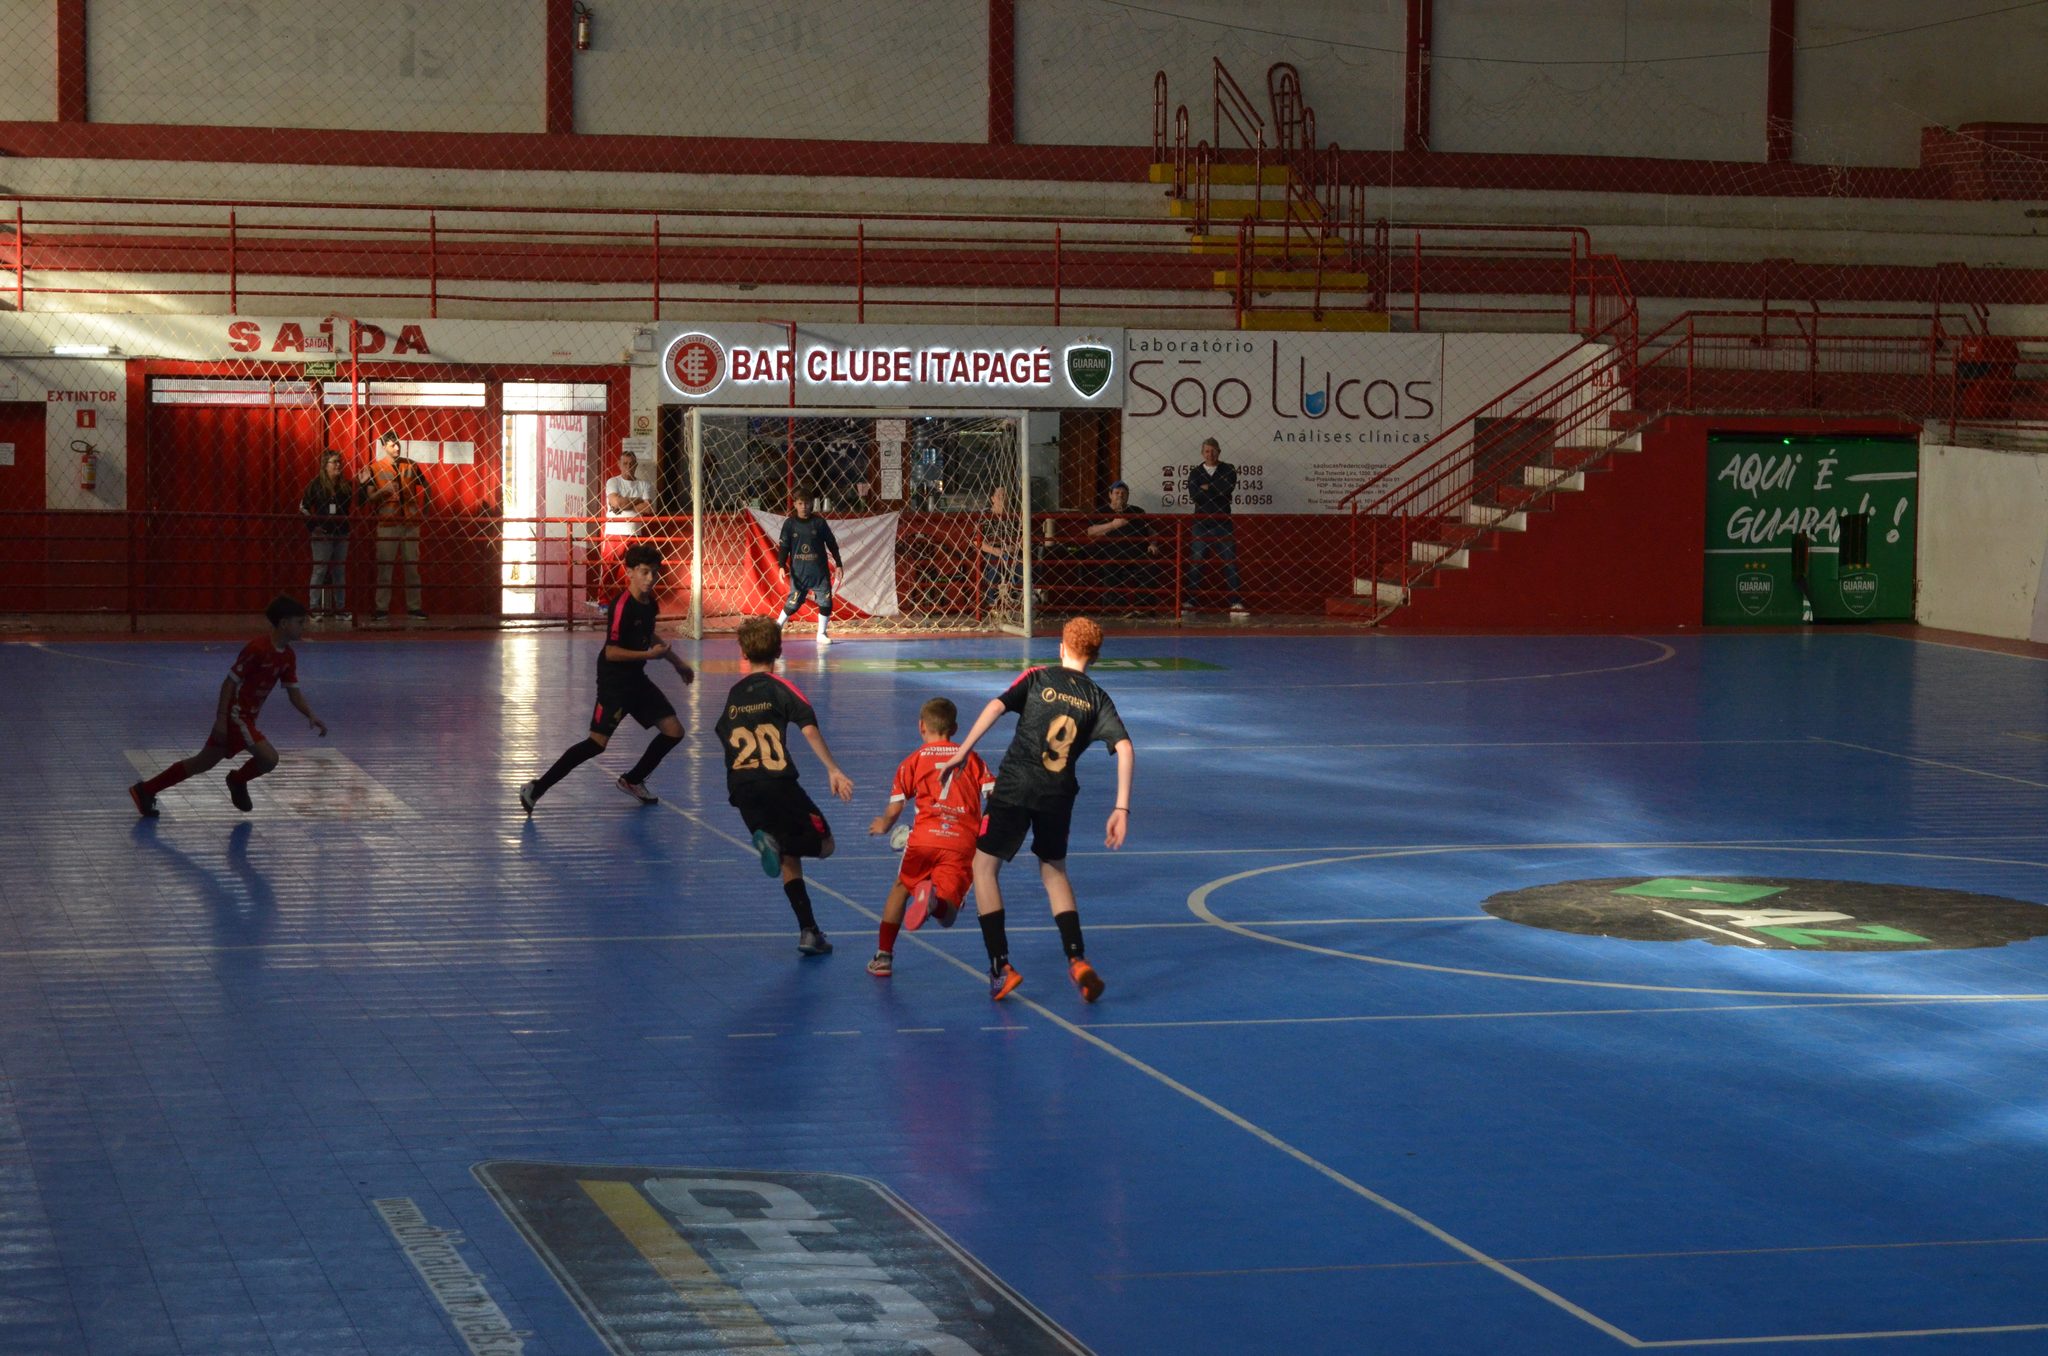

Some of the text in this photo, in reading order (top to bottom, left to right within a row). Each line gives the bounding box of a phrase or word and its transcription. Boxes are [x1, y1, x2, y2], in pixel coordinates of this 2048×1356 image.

[1129, 337, 1254, 353] Laboratório
[732, 346, 1051, 383] BAR CLUBE ITAPAGÉ
[1072, 358, 1106, 369] GUARANI
[47, 390, 117, 402] EXTINTOR
[1128, 359, 1251, 418] São
[1273, 429, 1431, 443] Análises clínicas
[546, 441, 586, 485] PANAFÉ
[1236, 465, 1263, 475] 4988
[1813, 448, 1838, 490] É
[1237, 480, 1263, 490] 1343
[1230, 494, 1273, 505] 6.0958
[1739, 581, 1771, 592] GUARANI
[1843, 580, 1875, 591] GUARANI
[737, 701, 772, 714] requinte
[729, 723, 788, 771] 20
[1042, 714, 1078, 773] 9
[934, 762, 954, 800] 7
[642, 1177, 980, 1356] CHIC
